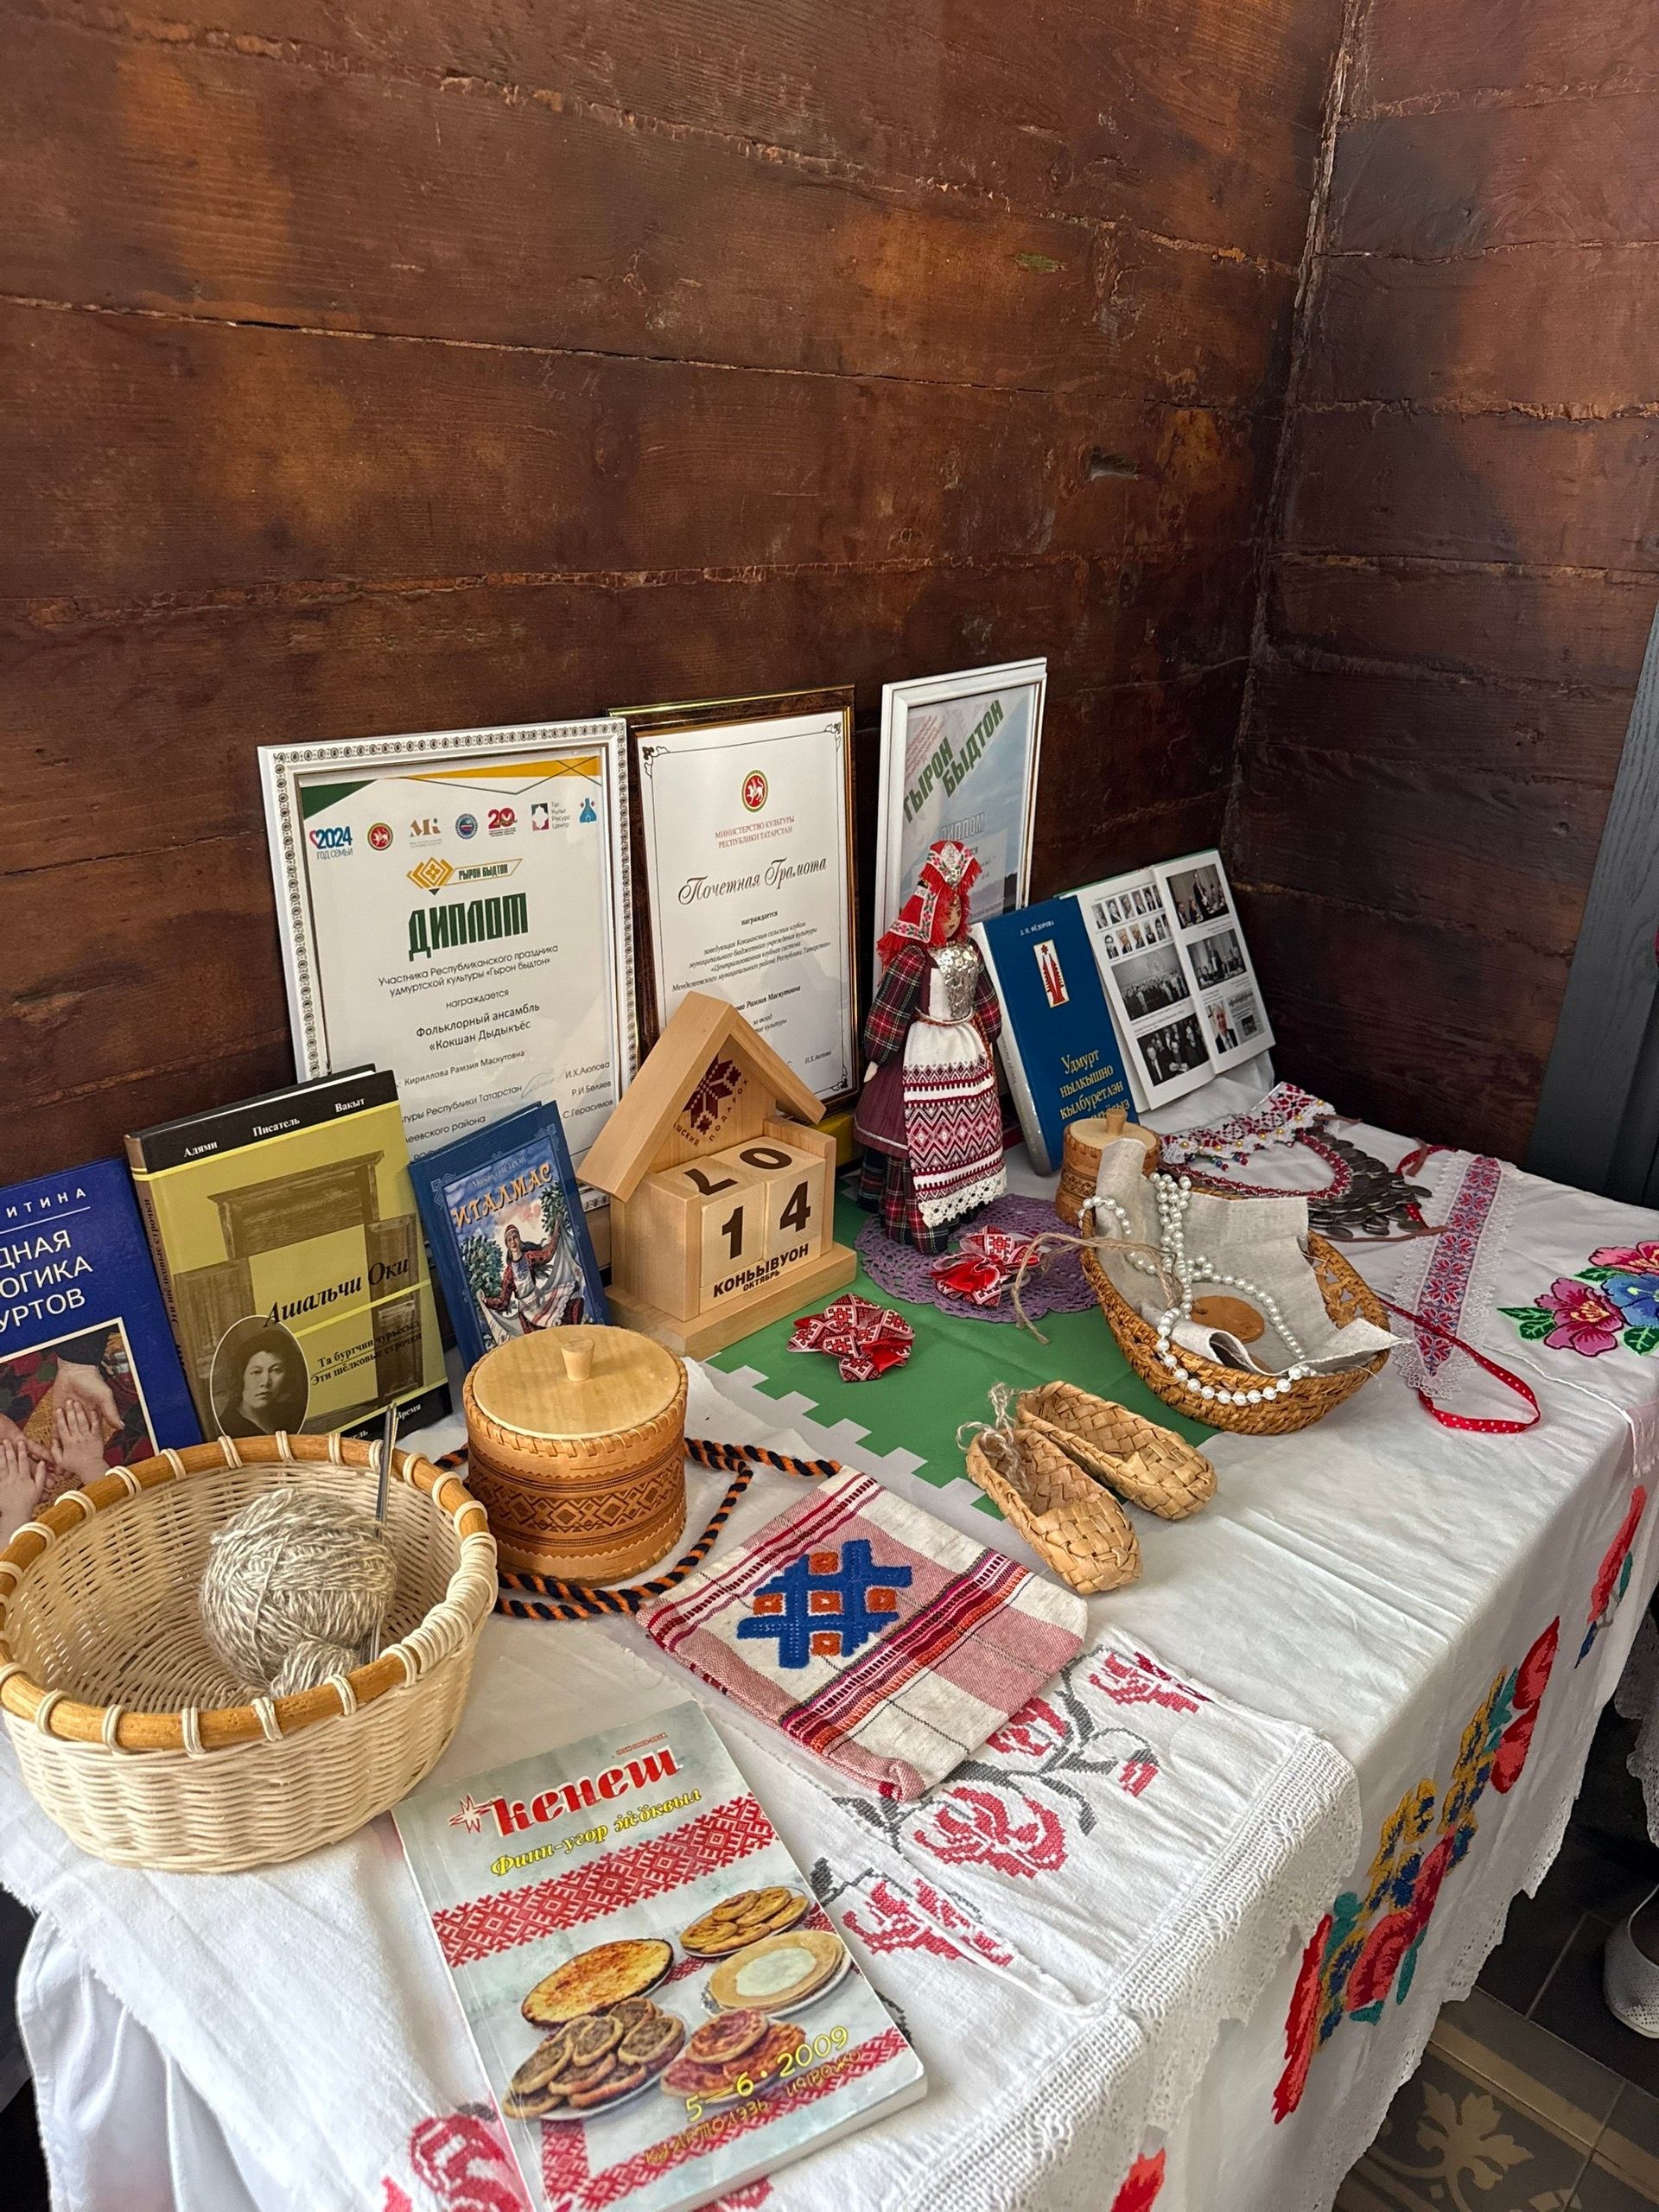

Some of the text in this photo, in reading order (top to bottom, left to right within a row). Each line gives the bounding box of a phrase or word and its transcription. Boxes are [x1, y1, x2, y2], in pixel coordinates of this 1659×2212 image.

[942, 699, 1003, 798] БЫДТОН
[316, 826, 353, 849] 2024
[715, 815, 795, 839] МИНИСТЕРСТВО КУЛЬТУРЫ
[718, 826, 792, 849] РЕСПУБЛИКИ ТАТАРСТАН
[316, 849, 353, 861] ГОД СЕМЬИ
[678, 857, 827, 905] Почетная Грамота
[409, 893, 529, 962] ДИПЛОМ
[741, 911, 778, 926] награждается
[378, 944, 558, 986] Участника Республиканского праздника
[389, 957, 550, 998] удмуртской культуры «Гырон быдтон»
[446, 988, 509, 1009] награждается
[416, 1002, 540, 1038] Фольклорный ансамбль
[429, 1034, 475, 1052] «Кокшан
[404, 1071, 448, 1086] Кириллова
[450, 1062, 479, 1076] Рамзия
[480, 1050, 525, 1068] Маскутовна
[1061, 1050, 1100, 1075] Удмурт
[1059, 1065, 1114, 1099] нылкышно
[426, 1097, 478, 1117] Республики
[479, 1085, 523, 1103] Татарстан
[563, 1098, 613, 1119] С.Герасимов
[1059, 1081, 1124, 1121] кылбуретлэн
[184, 1098, 365, 1158] Адями Писатель Вакыт
[451, 1116, 486, 1134] района
[6, 1187, 86, 1218] ИТИНА
[450, 1162, 553, 1230] ИТАЛМАС
[144, 1198, 161, 1244] строчки
[722, 1181, 811, 1259] 1 4
[0, 1255, 93, 1299] ОГИКА
[714, 1243, 809, 1298] КОНЬЫВУОН
[743, 1270, 780, 1292] ОКТЯБРЬ
[264, 1258, 409, 1328] Ашальчи Оки
[311, 1333, 422, 1386] Эти шёлковые строчки
[318, 1357, 332, 1368] Та
[334, 1339, 373, 1362] буртчин
[491, 1824, 608, 1877] Финн-угор
[777, 2025, 848, 2078] 2009
